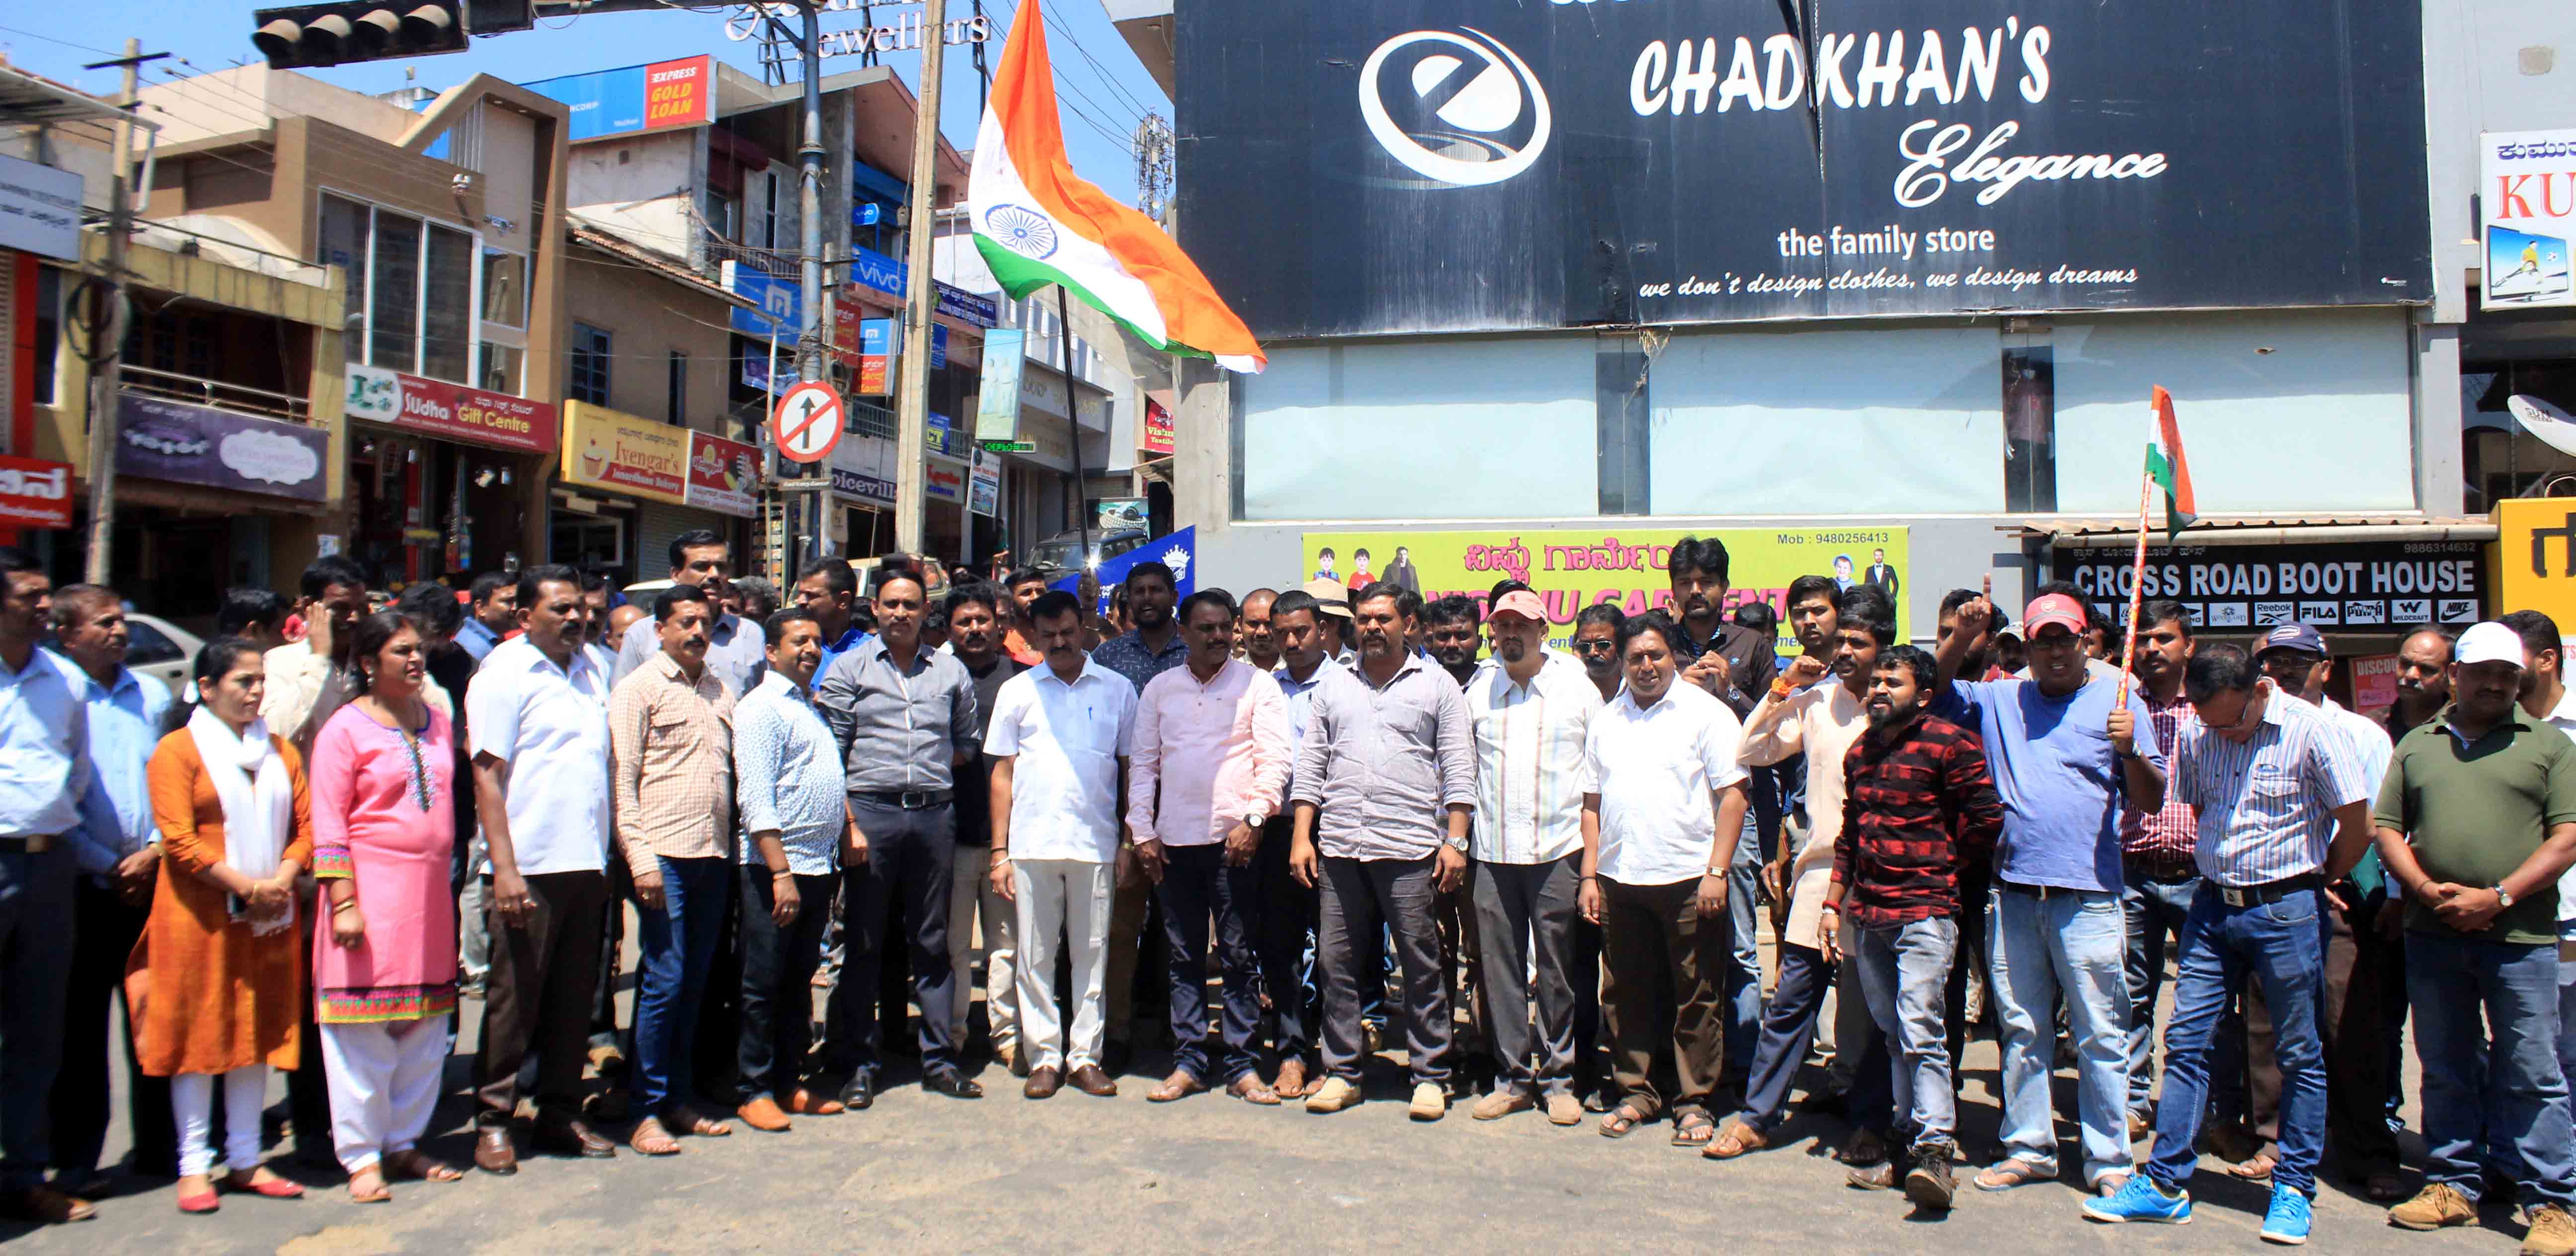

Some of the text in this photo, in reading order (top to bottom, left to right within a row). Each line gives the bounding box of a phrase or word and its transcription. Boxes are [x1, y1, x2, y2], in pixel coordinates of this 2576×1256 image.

[796, 11, 991, 59] ewellrs
[651, 67, 698, 83] EXPRESS
[1630, 15, 2050, 116] CHADKHAN'S
[651, 83, 692, 102] GOLD
[650, 98, 692, 119] LOAN
[1894, 119, 2167, 207] Elegance
[1777, 225, 1995, 260] the family store
[859, 262, 901, 291] vivo
[1639, 264, 2138, 298] we don't design clothes, we design dreams
[458, 405, 482, 424] Gift
[484, 411, 531, 433] Centre
[1777, 534, 1804, 545] Mob
[1816, 532, 1888, 544] 9480256413
[1543, 538, 1672, 572] ಗಾರ್ಮೆಂ
[2074, 560, 2474, 596] CROSS ROAD BOOT HOUSE
[2302, 607, 2336, 619] FILA
[2446, 602, 2470, 613] NIKE
